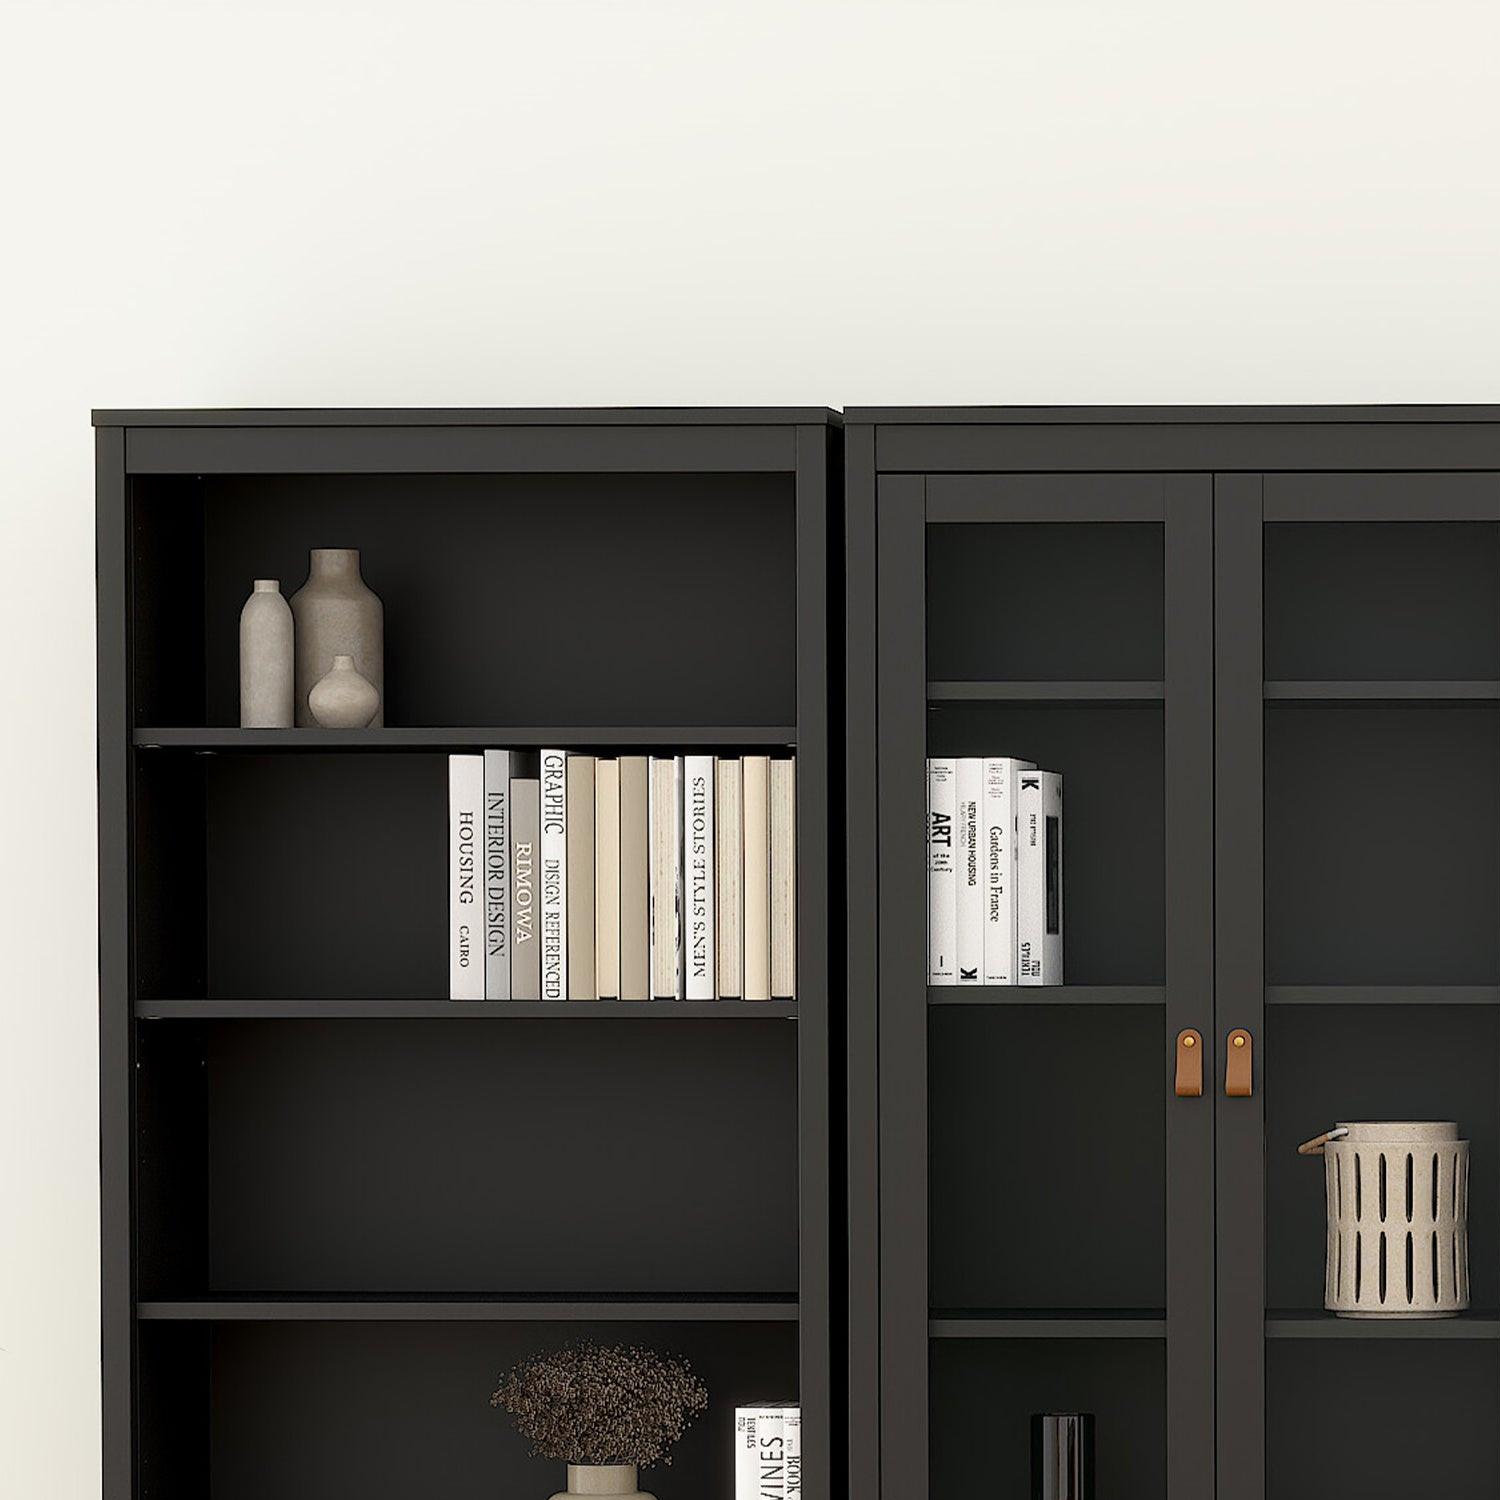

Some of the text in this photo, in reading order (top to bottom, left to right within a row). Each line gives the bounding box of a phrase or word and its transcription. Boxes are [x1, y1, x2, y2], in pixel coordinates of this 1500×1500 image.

[545, 755, 563, 834] GRAPHIC
[932, 811, 951, 847] ART
[488, 792, 504, 957] INTERIOR DESIGN
[693, 776, 706, 977] MEN'S STYLE STORIES
[967, 801, 977, 886] NEW URBAN HOUSING
[990, 826, 1003, 923] Gardens in France
[459, 812, 474, 968] HOUSING CAIRO
[516, 842, 532, 944] RIMOWA
[545, 912, 559, 1000] REFERENCED
[787, 1456, 801, 1493] BOOK
